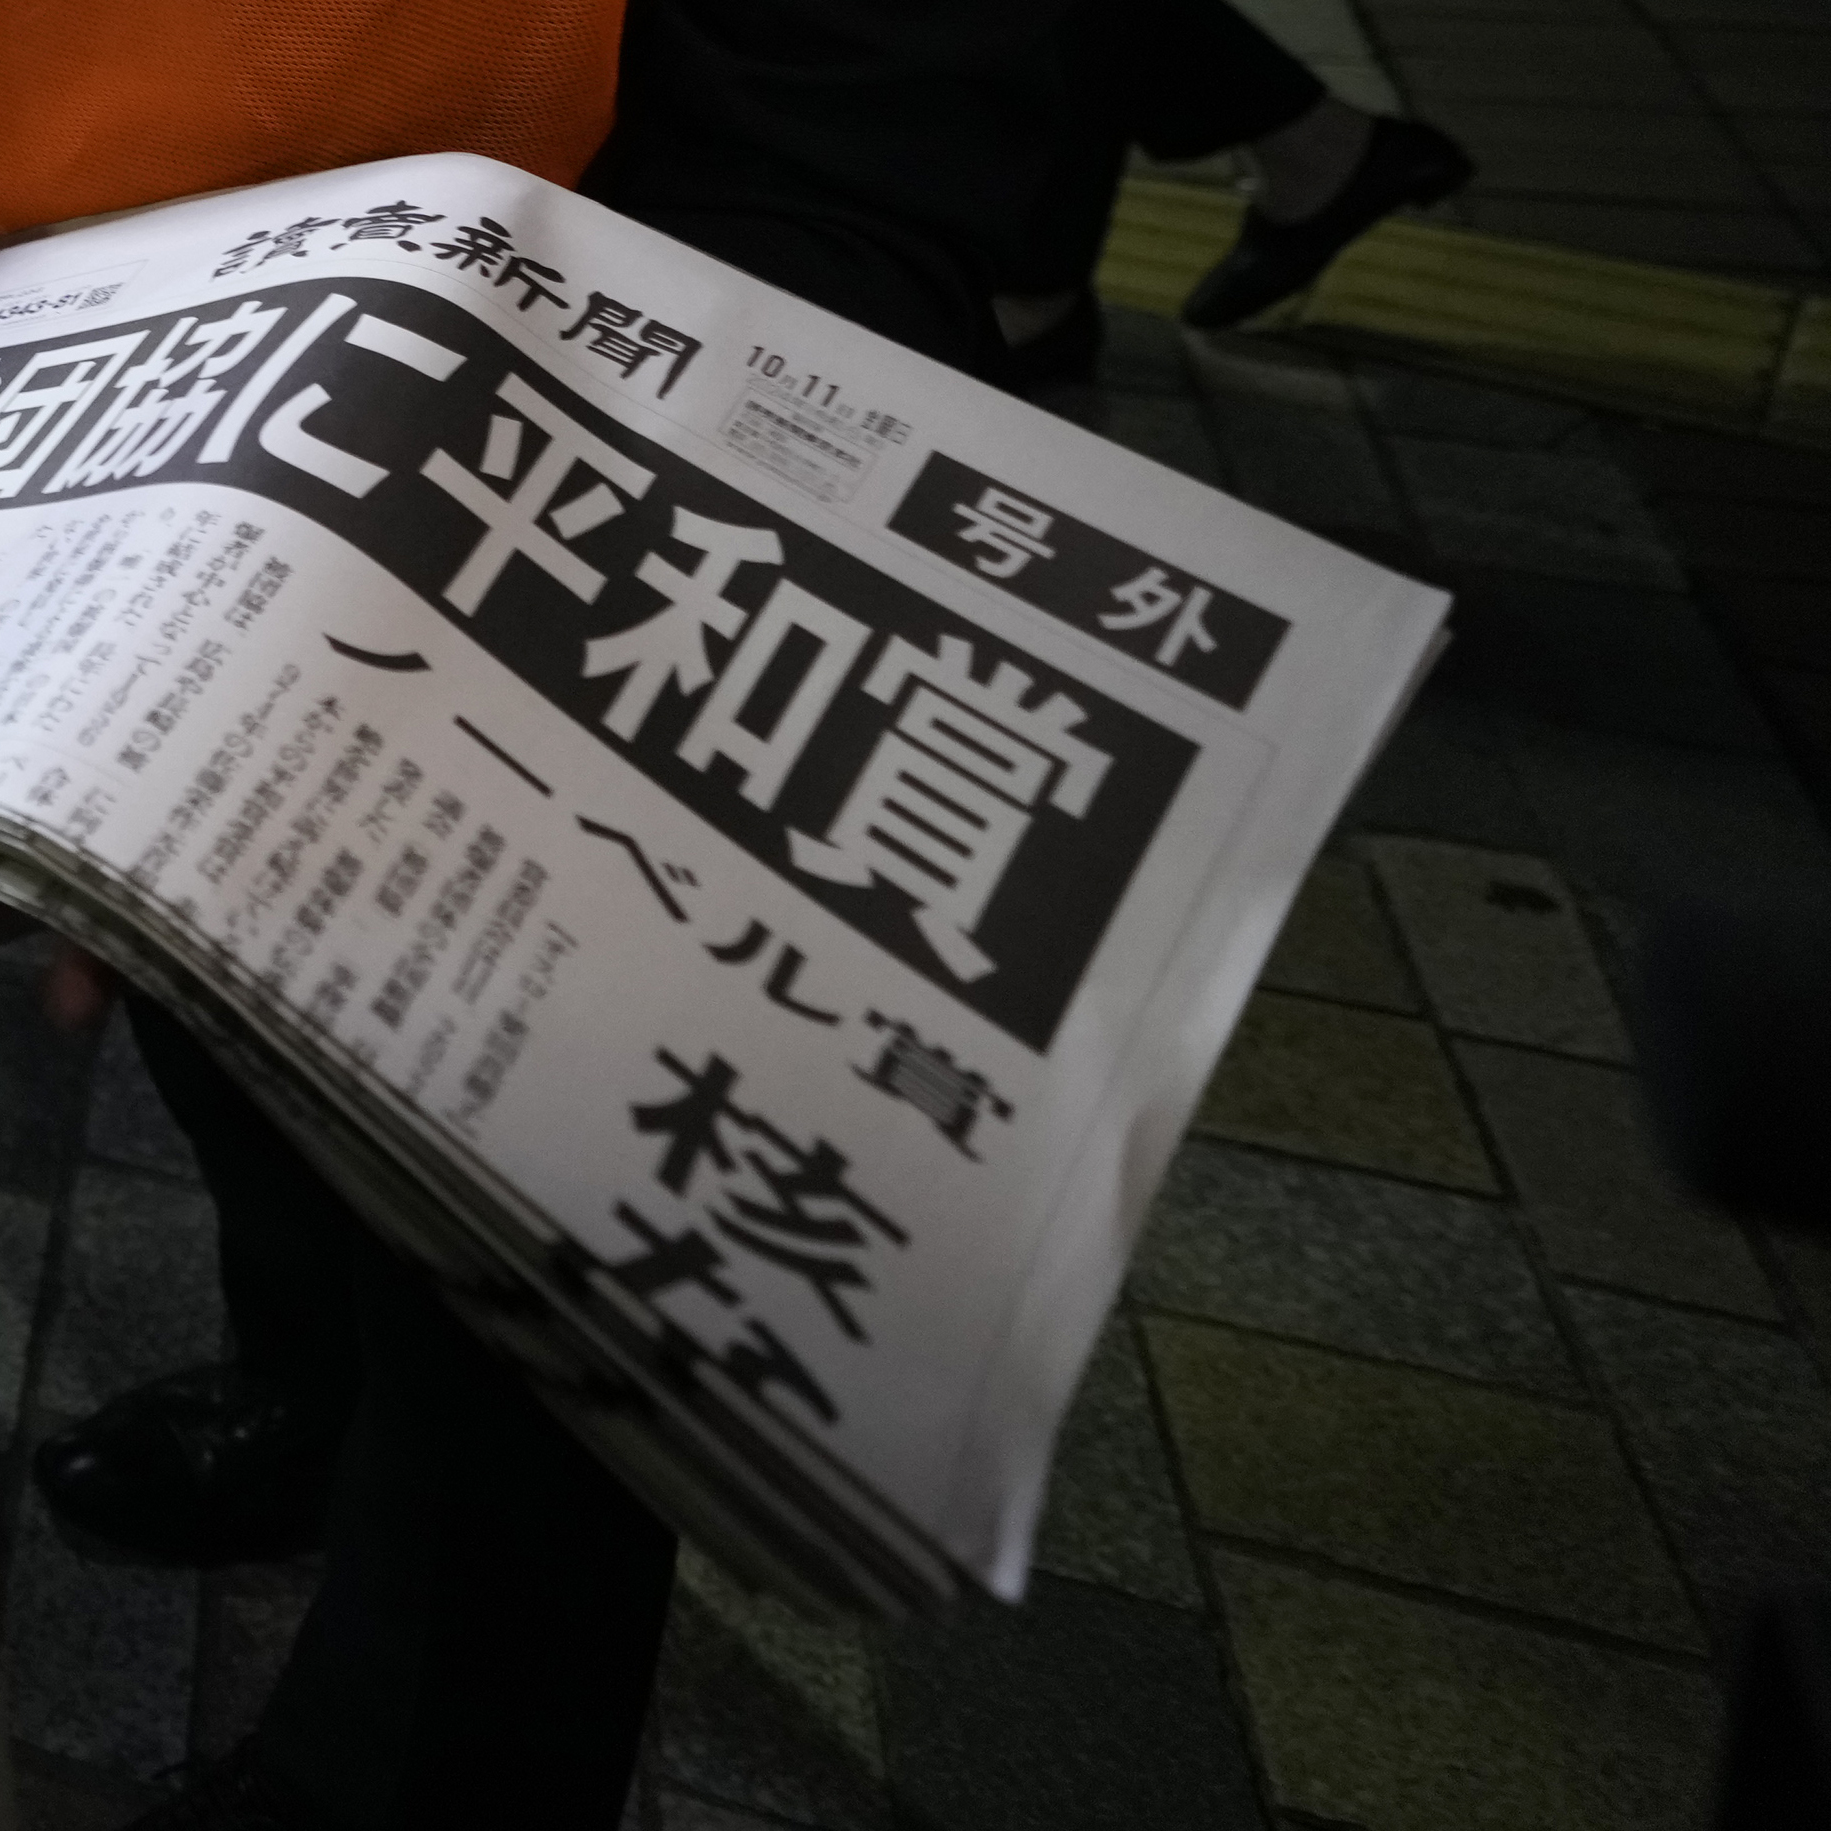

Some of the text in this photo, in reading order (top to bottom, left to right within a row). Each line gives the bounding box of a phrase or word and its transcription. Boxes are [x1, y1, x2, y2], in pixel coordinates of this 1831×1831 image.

[952, 484, 1219, 670] 号外
[321, 631, 1015, 1164] ノーベル賞
